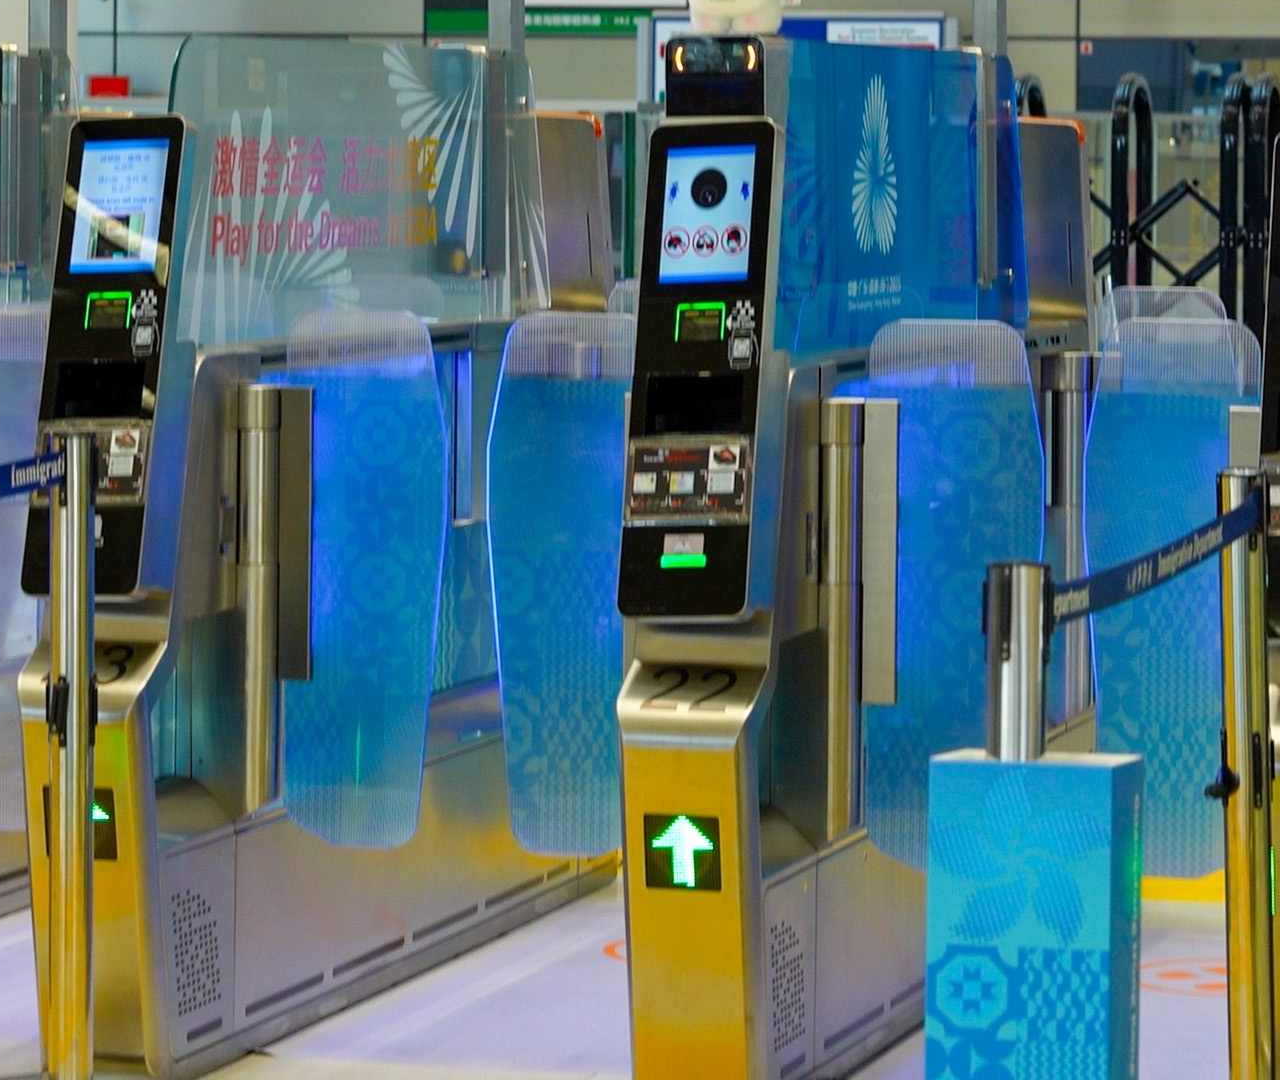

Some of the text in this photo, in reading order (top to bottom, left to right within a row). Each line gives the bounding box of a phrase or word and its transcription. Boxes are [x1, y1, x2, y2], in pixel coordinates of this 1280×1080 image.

[212, 135, 327, 198] 激情全运会
[211, 213, 252, 268] Play
[257, 210, 282, 254] for
[288, 208, 315, 254] the
[319, 210, 382, 251] Dreams
[641, 665, 738, 712] 22
